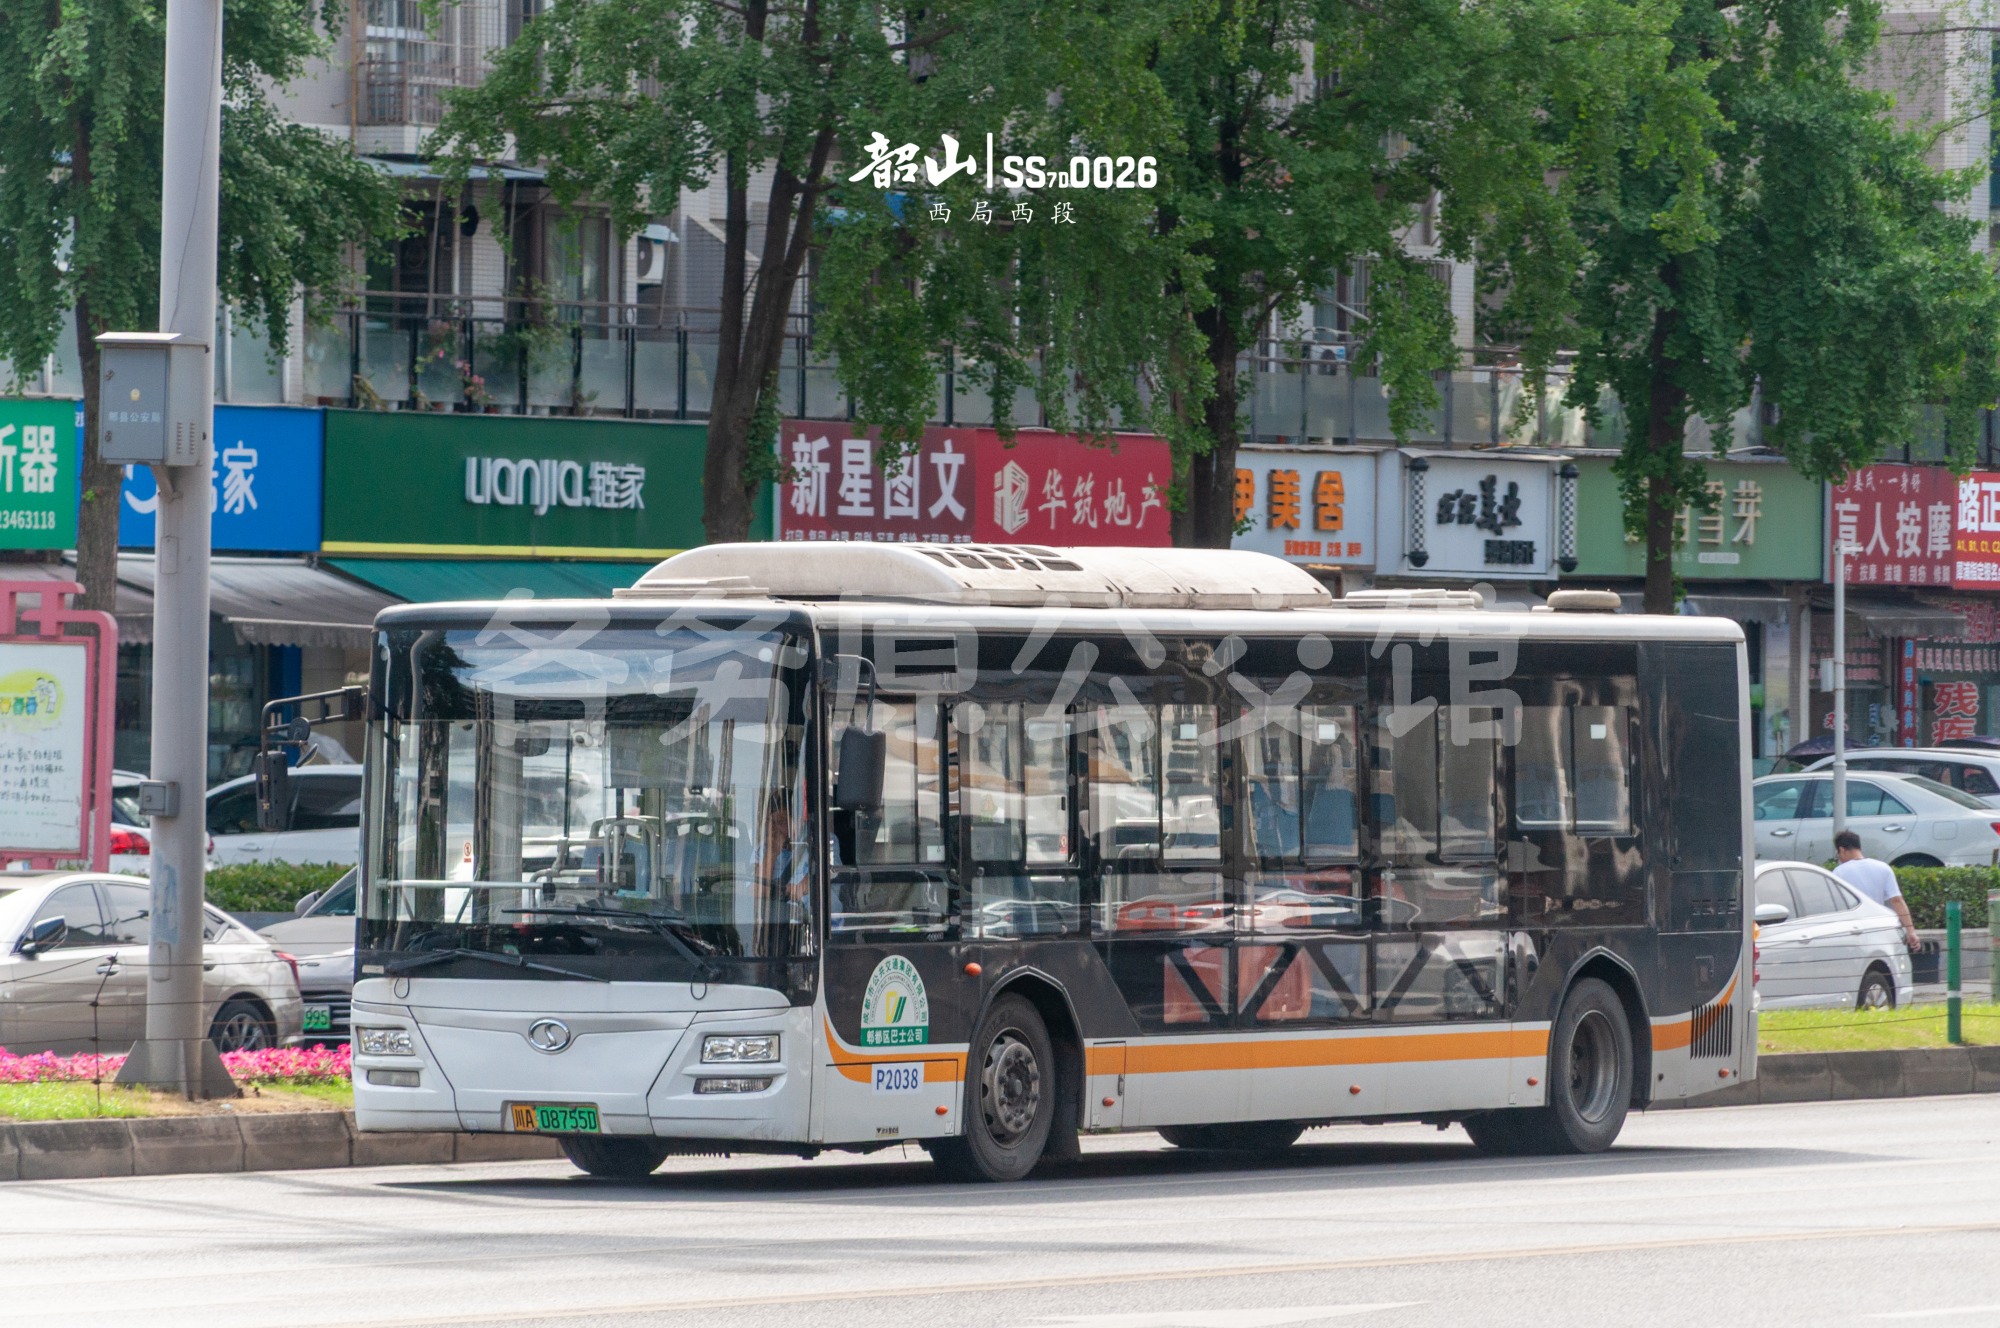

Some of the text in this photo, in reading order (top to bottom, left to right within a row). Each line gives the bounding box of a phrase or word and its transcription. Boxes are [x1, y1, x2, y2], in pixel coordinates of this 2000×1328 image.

[211, 440, 258, 515] 家
[790, 433, 966, 521] 新星图文
[1037, 467, 1163, 531] 华筑地产
[0, 510, 56, 530] 3463118
[1835, 498, 1952, 559] 盲人按摩
[866, 1028, 923, 1044] 郫都区巴士公司
[876, 1068, 918, 1090] P2038
